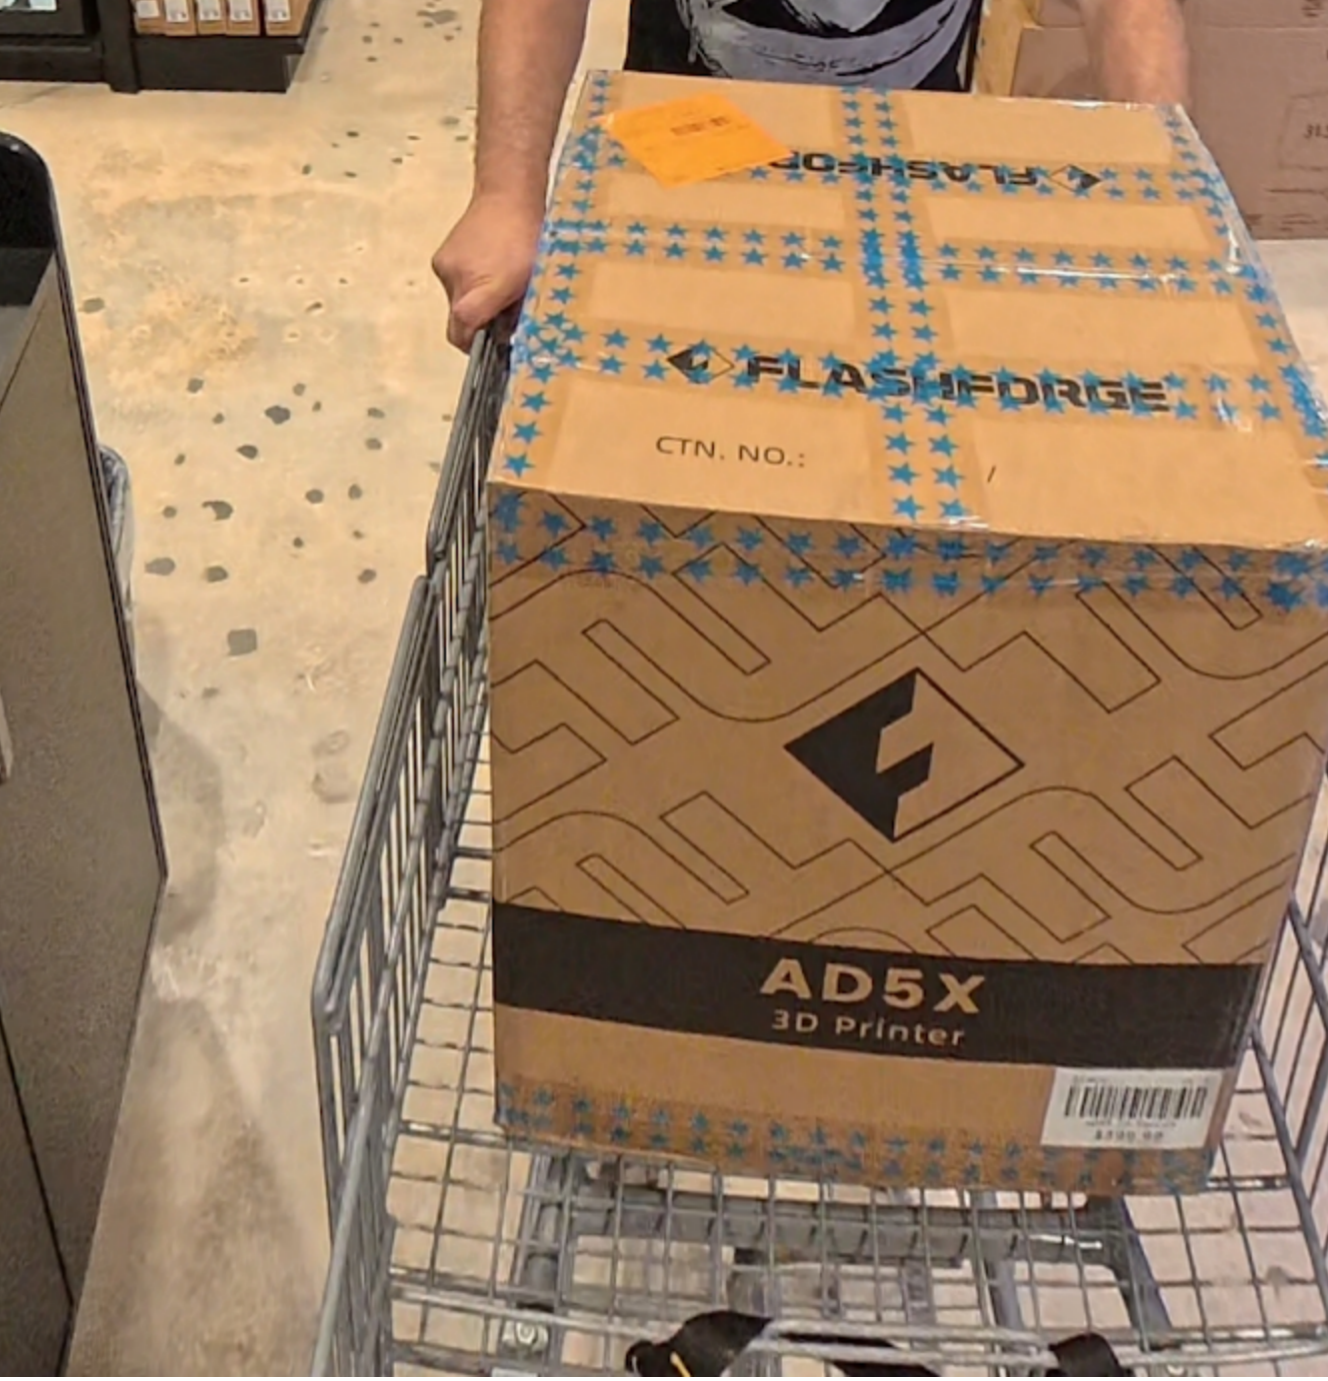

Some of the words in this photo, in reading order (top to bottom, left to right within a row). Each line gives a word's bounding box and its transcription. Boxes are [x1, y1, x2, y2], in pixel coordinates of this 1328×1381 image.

[769, 150, 1039, 186] FLASHFOR
[746, 355, 1170, 414] FLASHFORGE
[655, 435, 726, 461] CTN.
[737, 443, 806, 468] NO.:
[759, 957, 985, 1014] AD5X
[771, 1009, 819, 1033] 3D
[835, 1015, 966, 1047] Printer
